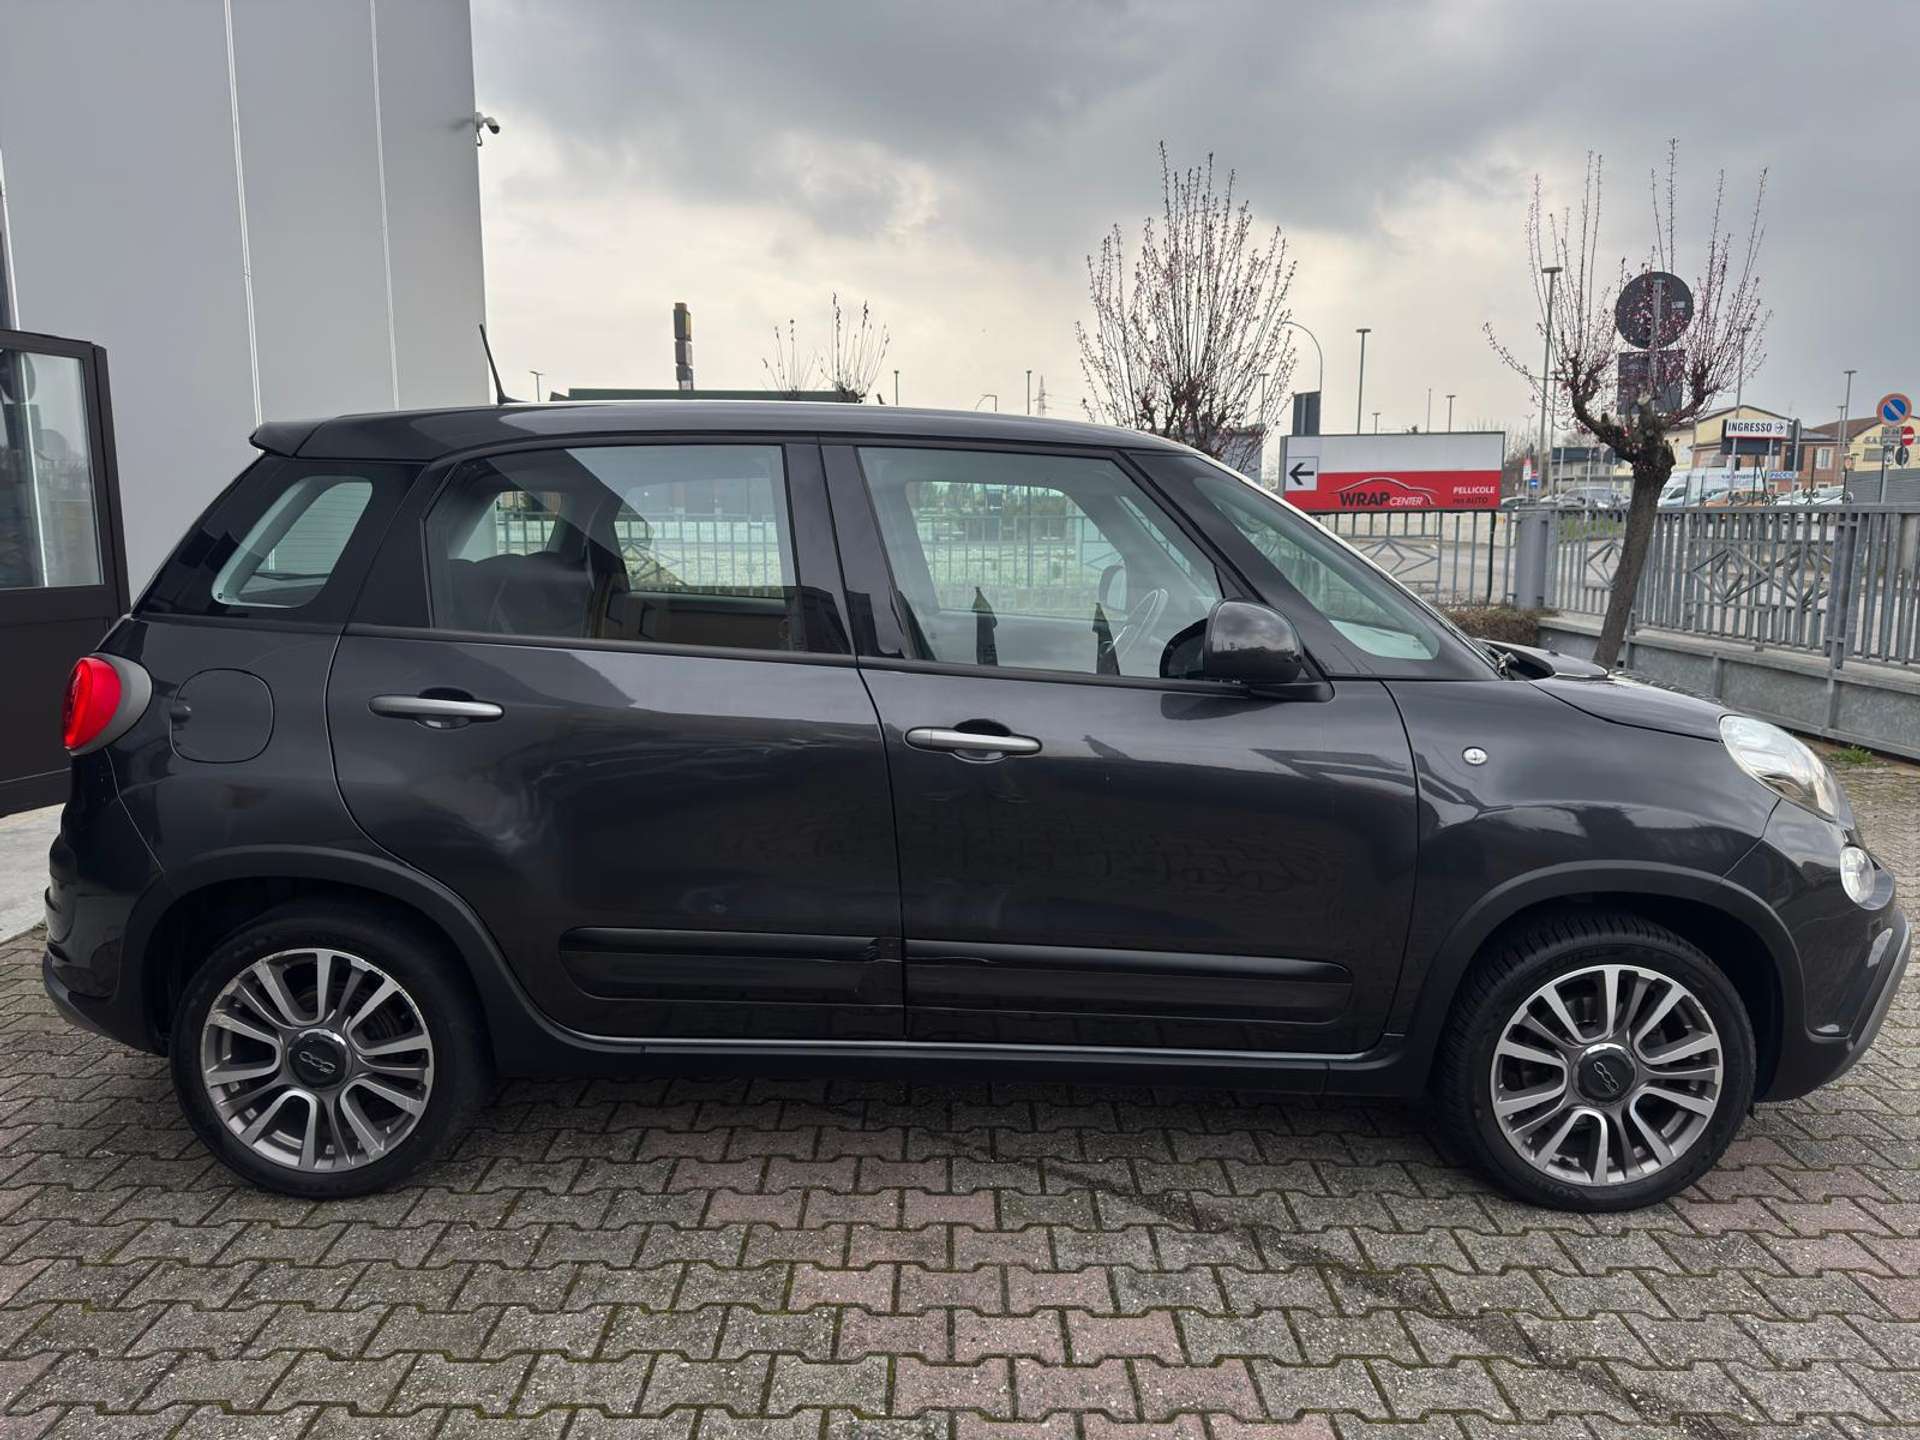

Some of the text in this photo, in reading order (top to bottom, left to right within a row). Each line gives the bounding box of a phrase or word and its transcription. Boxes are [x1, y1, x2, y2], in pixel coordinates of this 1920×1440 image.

[1728, 422, 1772, 432] INGRESSO
[1453, 486, 1496, 495] PELLICOLE
[1340, 491, 1423, 506] WRAP CENTER
